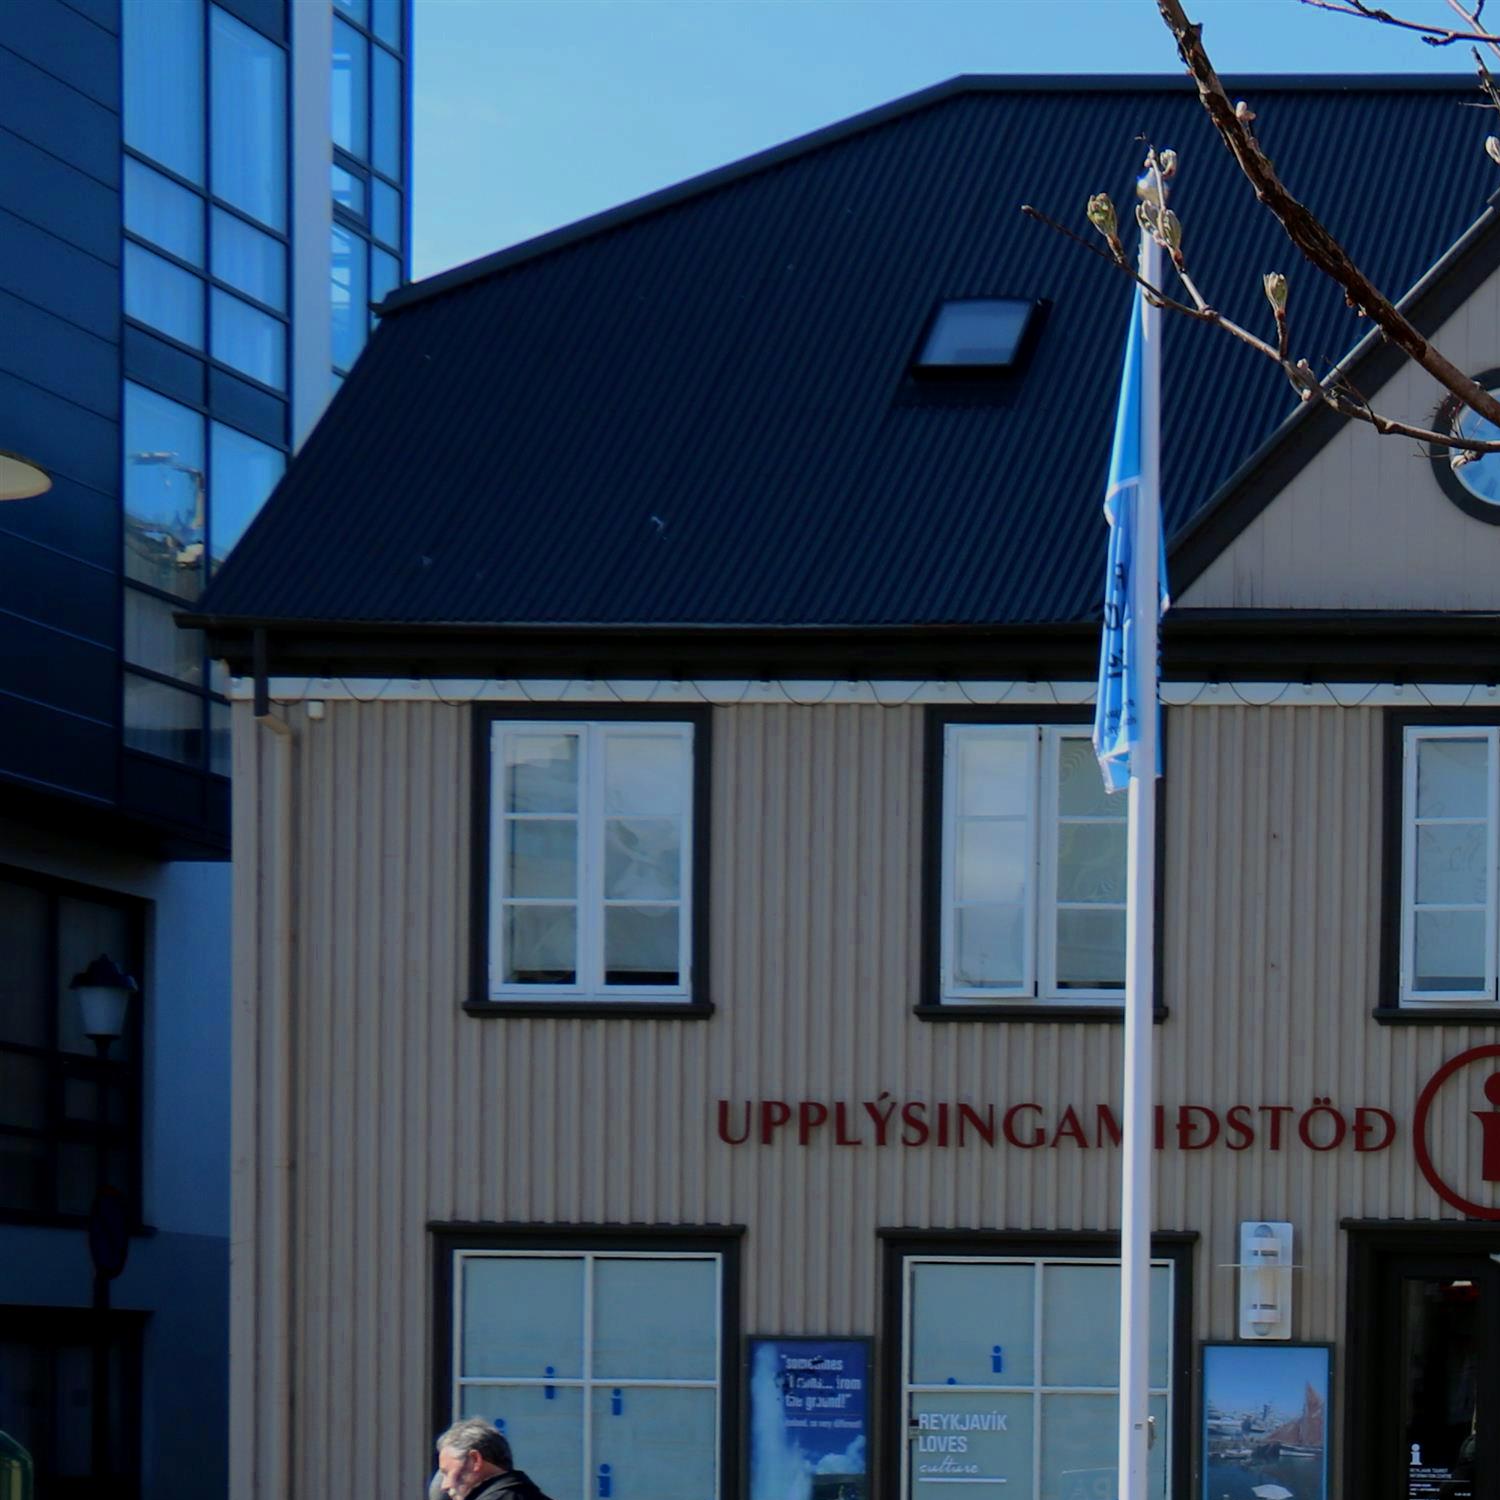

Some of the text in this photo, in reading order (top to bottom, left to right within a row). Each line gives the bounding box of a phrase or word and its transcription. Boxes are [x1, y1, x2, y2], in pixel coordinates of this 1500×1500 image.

[918, 1410, 1008, 1431] REYKJAVÍK
[918, 1435, 968, 1453] LOVES
[919, 1455, 980, 1474] culture
